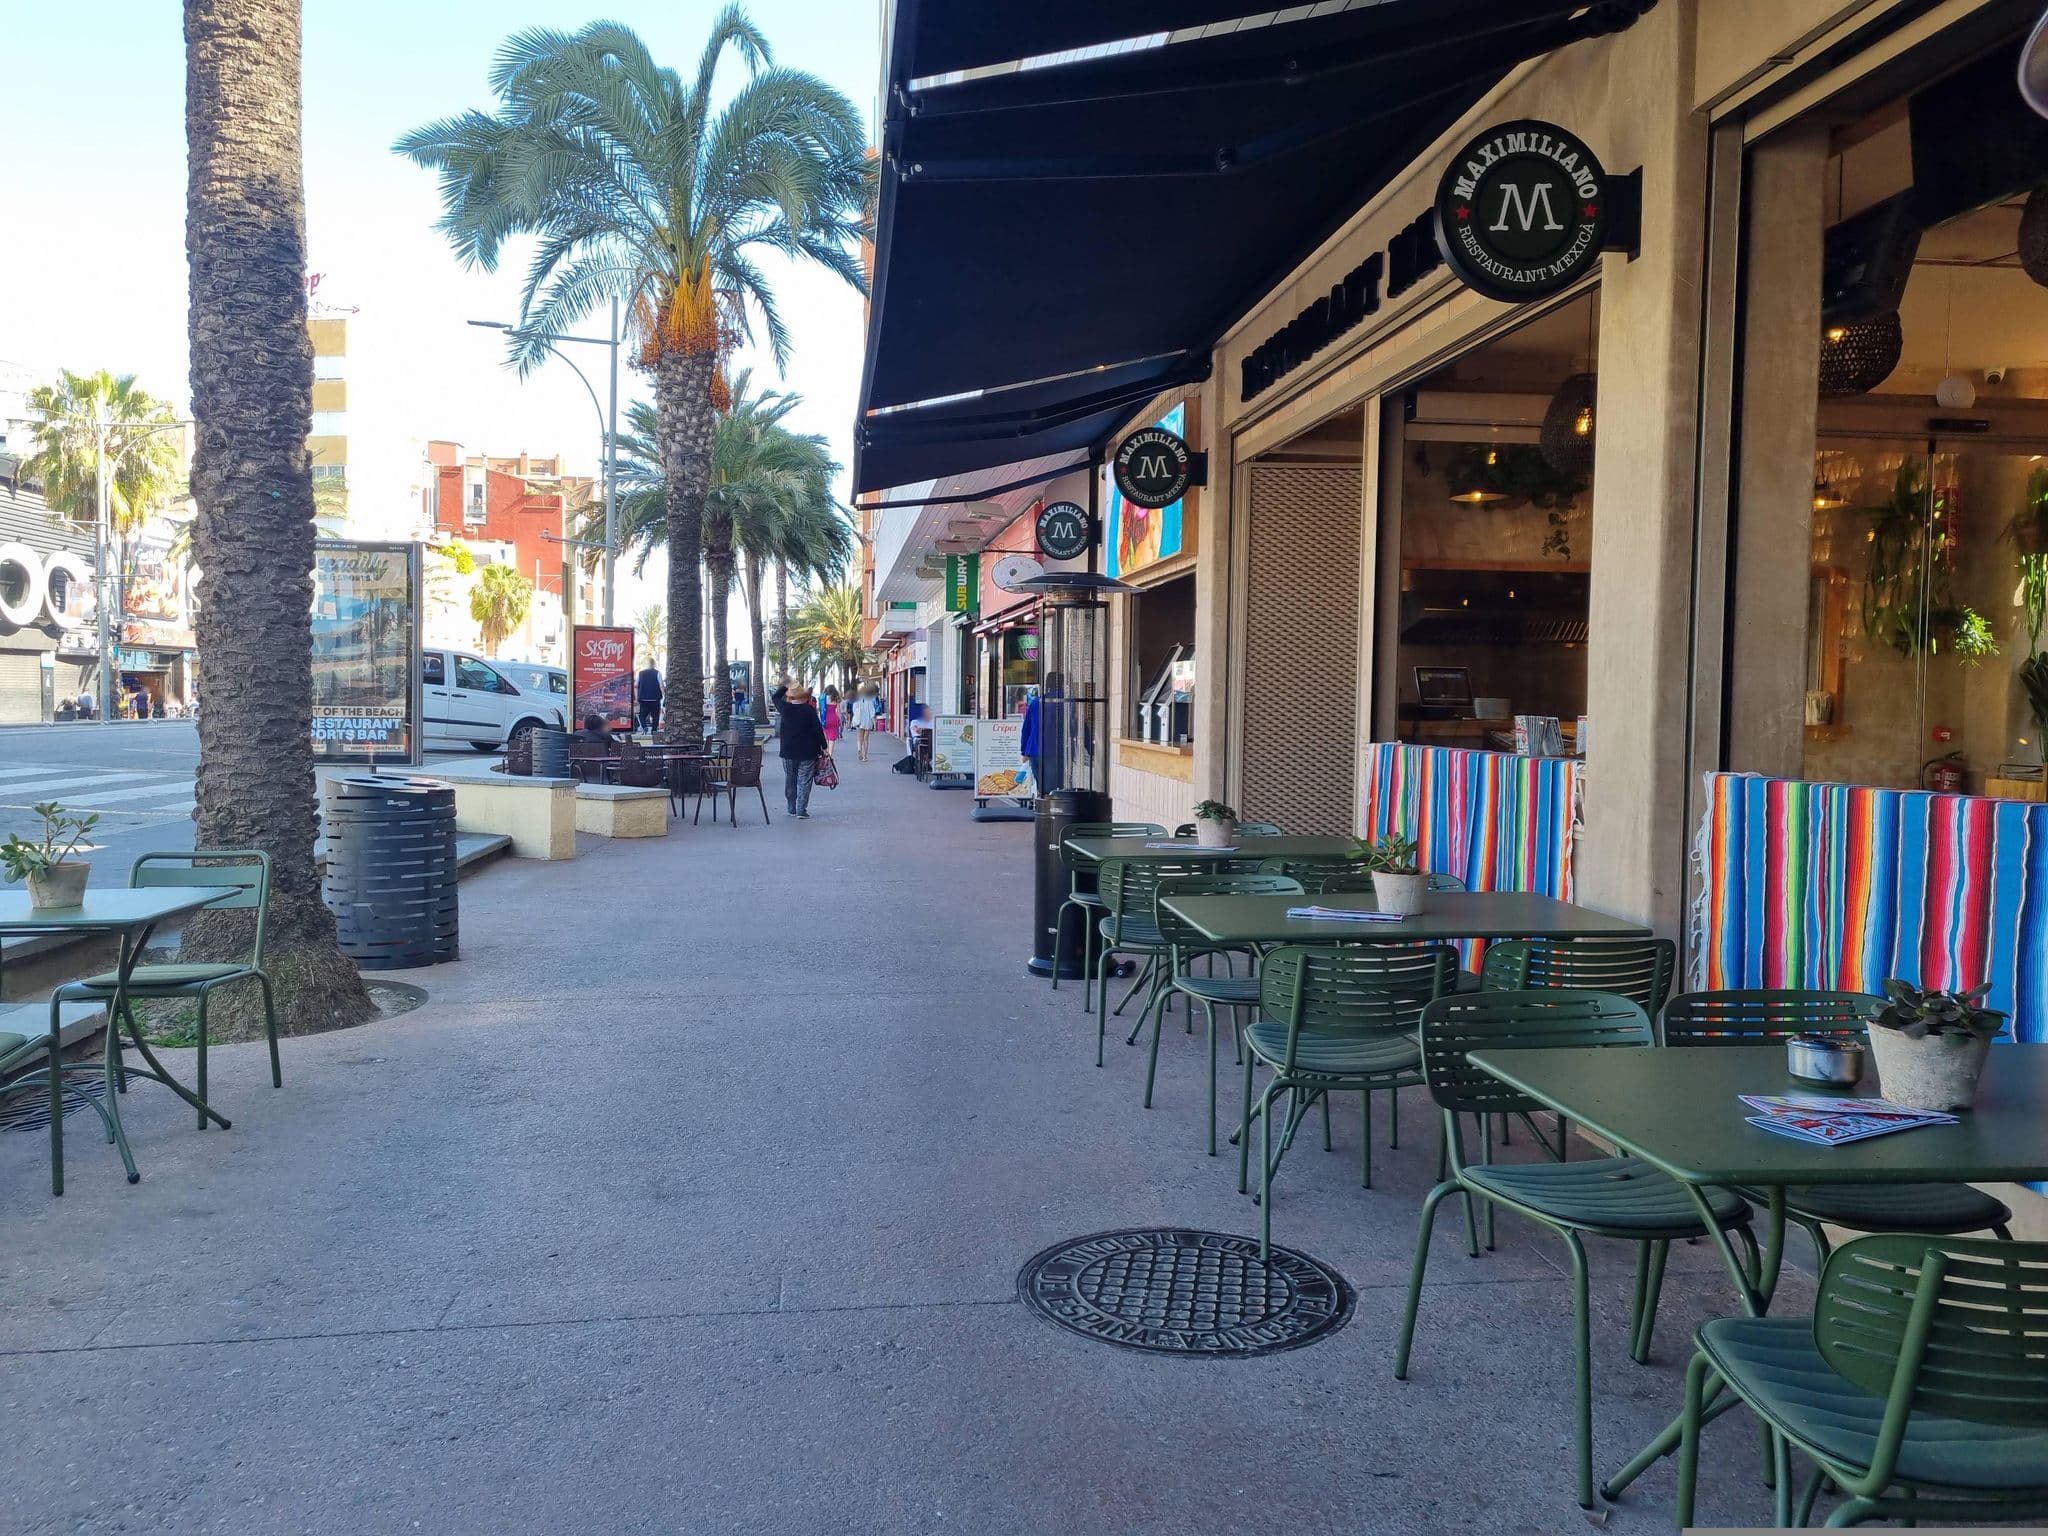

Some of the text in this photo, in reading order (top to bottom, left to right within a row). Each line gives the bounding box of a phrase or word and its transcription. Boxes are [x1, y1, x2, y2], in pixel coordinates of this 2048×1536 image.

[1454, 132, 1598, 200] MAXIMILIANO
[1489, 183, 1564, 231] M
[1459, 224, 1547, 283] RESTAURANT
[1119, 432, 1188, 465] MAXIMILIANO
[1136, 455, 1172, 479] M
[1122, 475, 1166, 503] RESTAURANT
[1040, 505, 1089, 529] MAXIMILIANO
[1051, 521, 1077, 539] M
[956, 556, 967, 610] SUBWAY
[323, 707, 338, 716] OF
[340, 707, 363, 716] THE
[365, 707, 404, 716] BEACH
[357, 729, 387, 740] BAR
[1052, 1233, 1180, 1265] NACIONAL
[1038, 1273, 1073, 1291] DE
